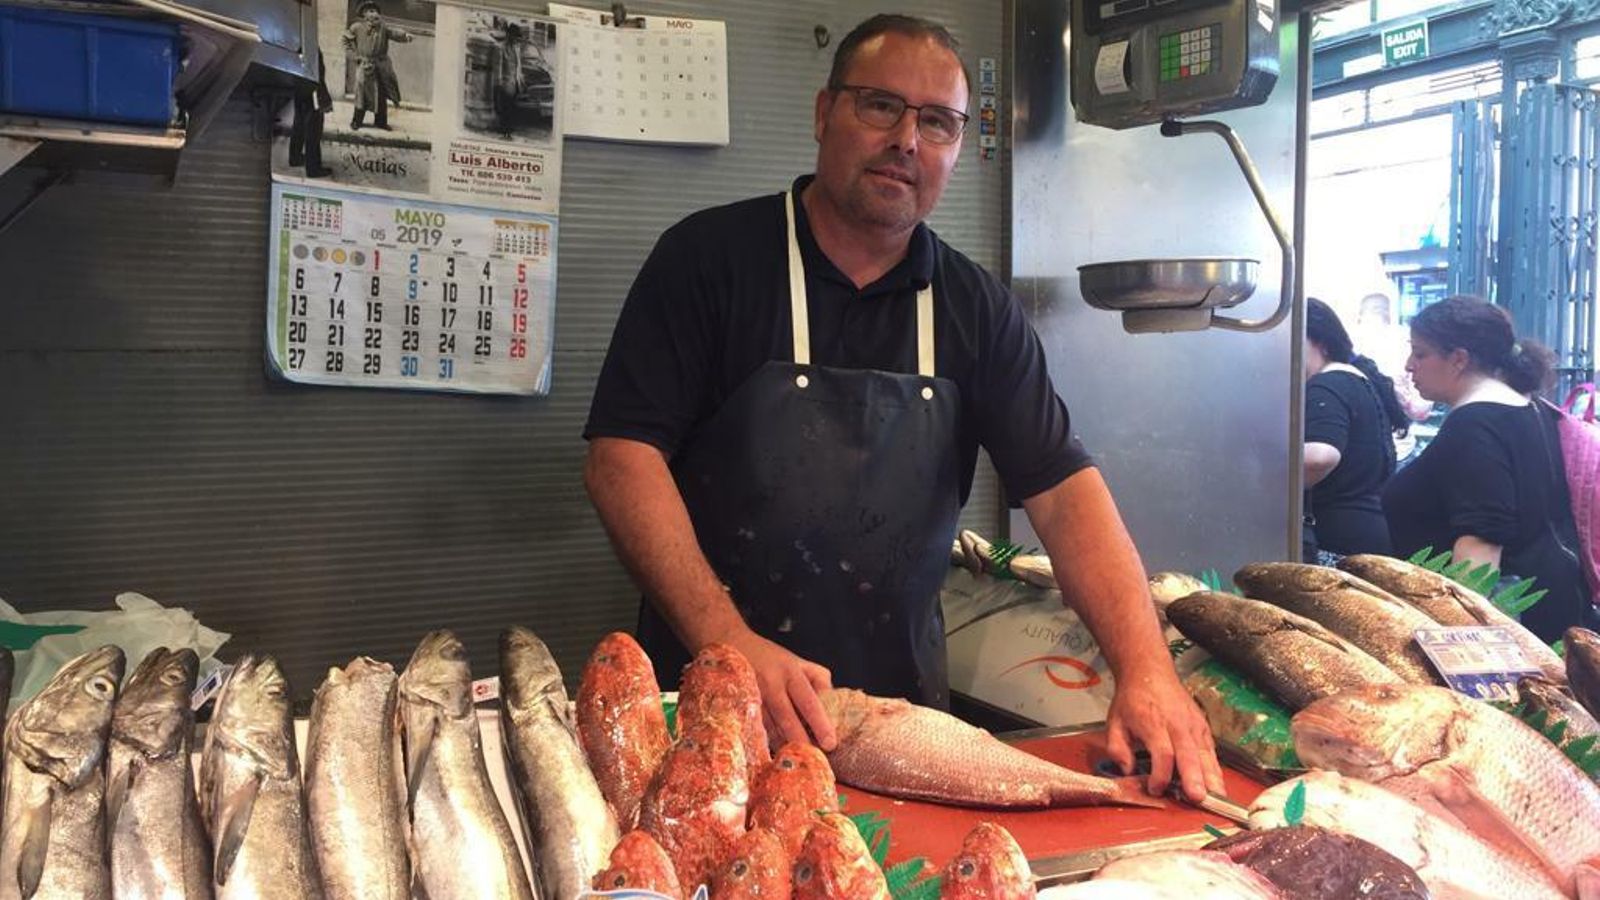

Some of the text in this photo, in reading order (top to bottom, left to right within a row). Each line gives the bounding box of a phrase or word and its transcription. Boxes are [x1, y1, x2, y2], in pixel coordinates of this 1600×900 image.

[666, 20, 694, 29] MAYO
[1386, 28, 1424, 47] SALIDA
[1393, 42, 1417, 59] EXIT
[451, 153, 541, 173] Luis Alberto
[395, 208, 446, 228] MAYO
[371, 226, 443, 247] 05 2019
[374, 250, 526, 283] 1 2 3 4 5
[295, 268, 529, 308] 6 7 8 9 10 11 12
[291, 294, 527, 333] 13 14 15 16 17 18 19
[289, 321, 526, 358] 20 21 22 23 24 25 26
[289, 348, 453, 379] 27 28 29 30 31
[1023, 623, 1083, 649] QUALITY
